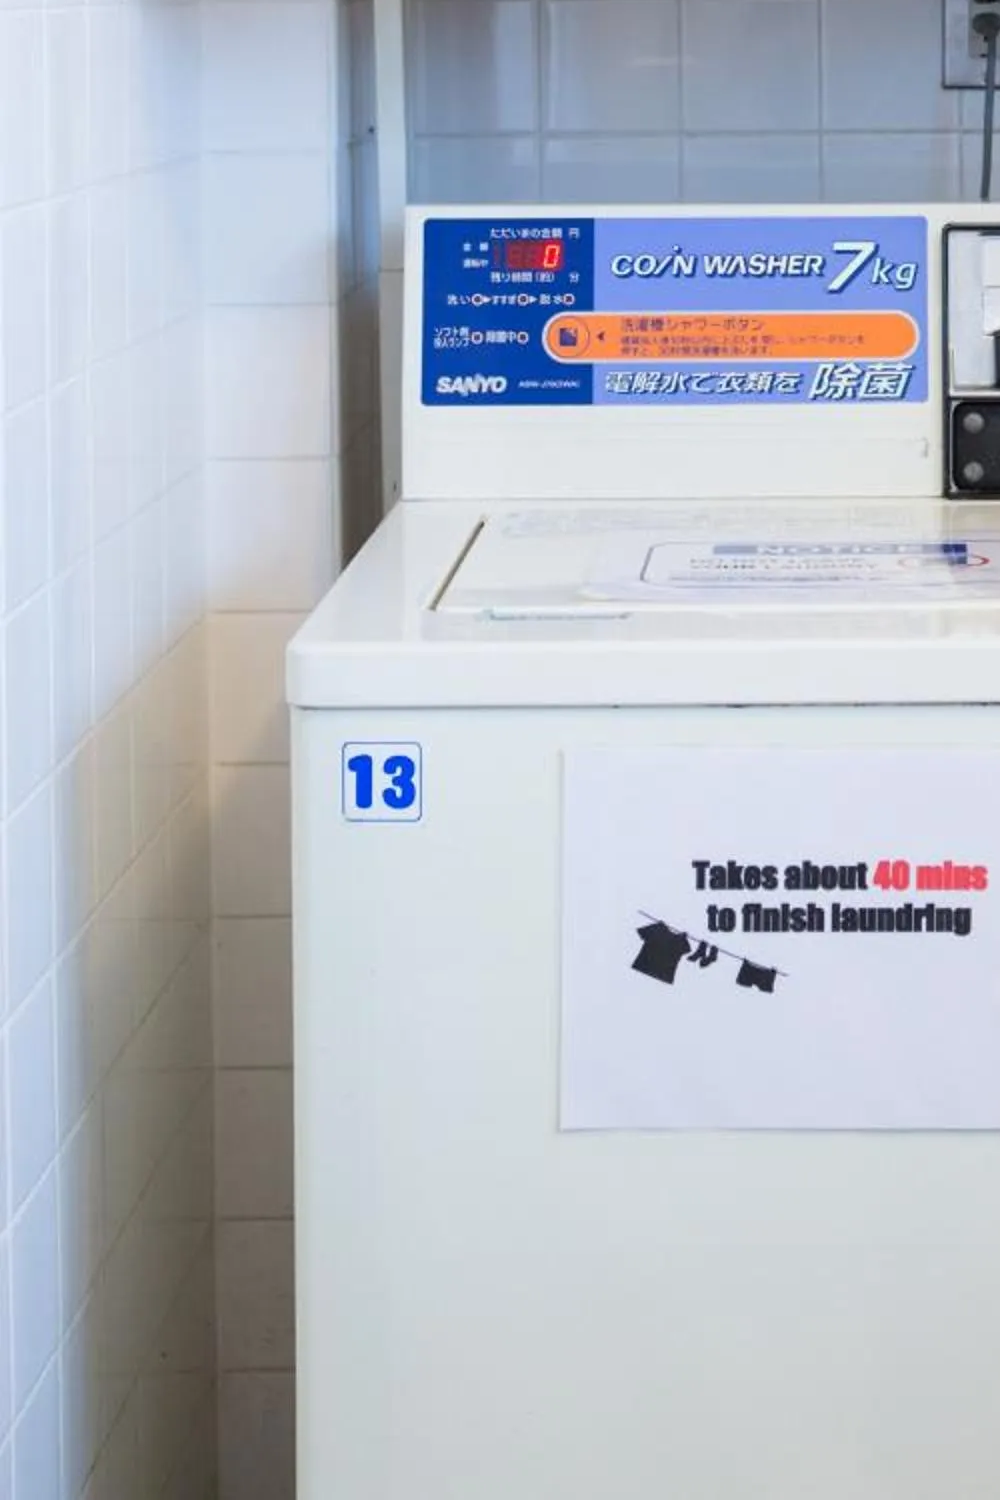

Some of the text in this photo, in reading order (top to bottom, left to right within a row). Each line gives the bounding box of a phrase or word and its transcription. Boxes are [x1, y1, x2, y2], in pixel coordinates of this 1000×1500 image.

[543, 244, 561, 269] 0
[610, 243, 694, 278] COIN
[703, 254, 824, 278] WASHER
[435, 373, 508, 397] SANYO
[605, 362, 915, 400] 電解水で衣類を 除菌
[348, 755, 416, 809] 13
[692, 860, 989, 892] Takes about 40 mins
[706, 903, 972, 937] to finish laundring
